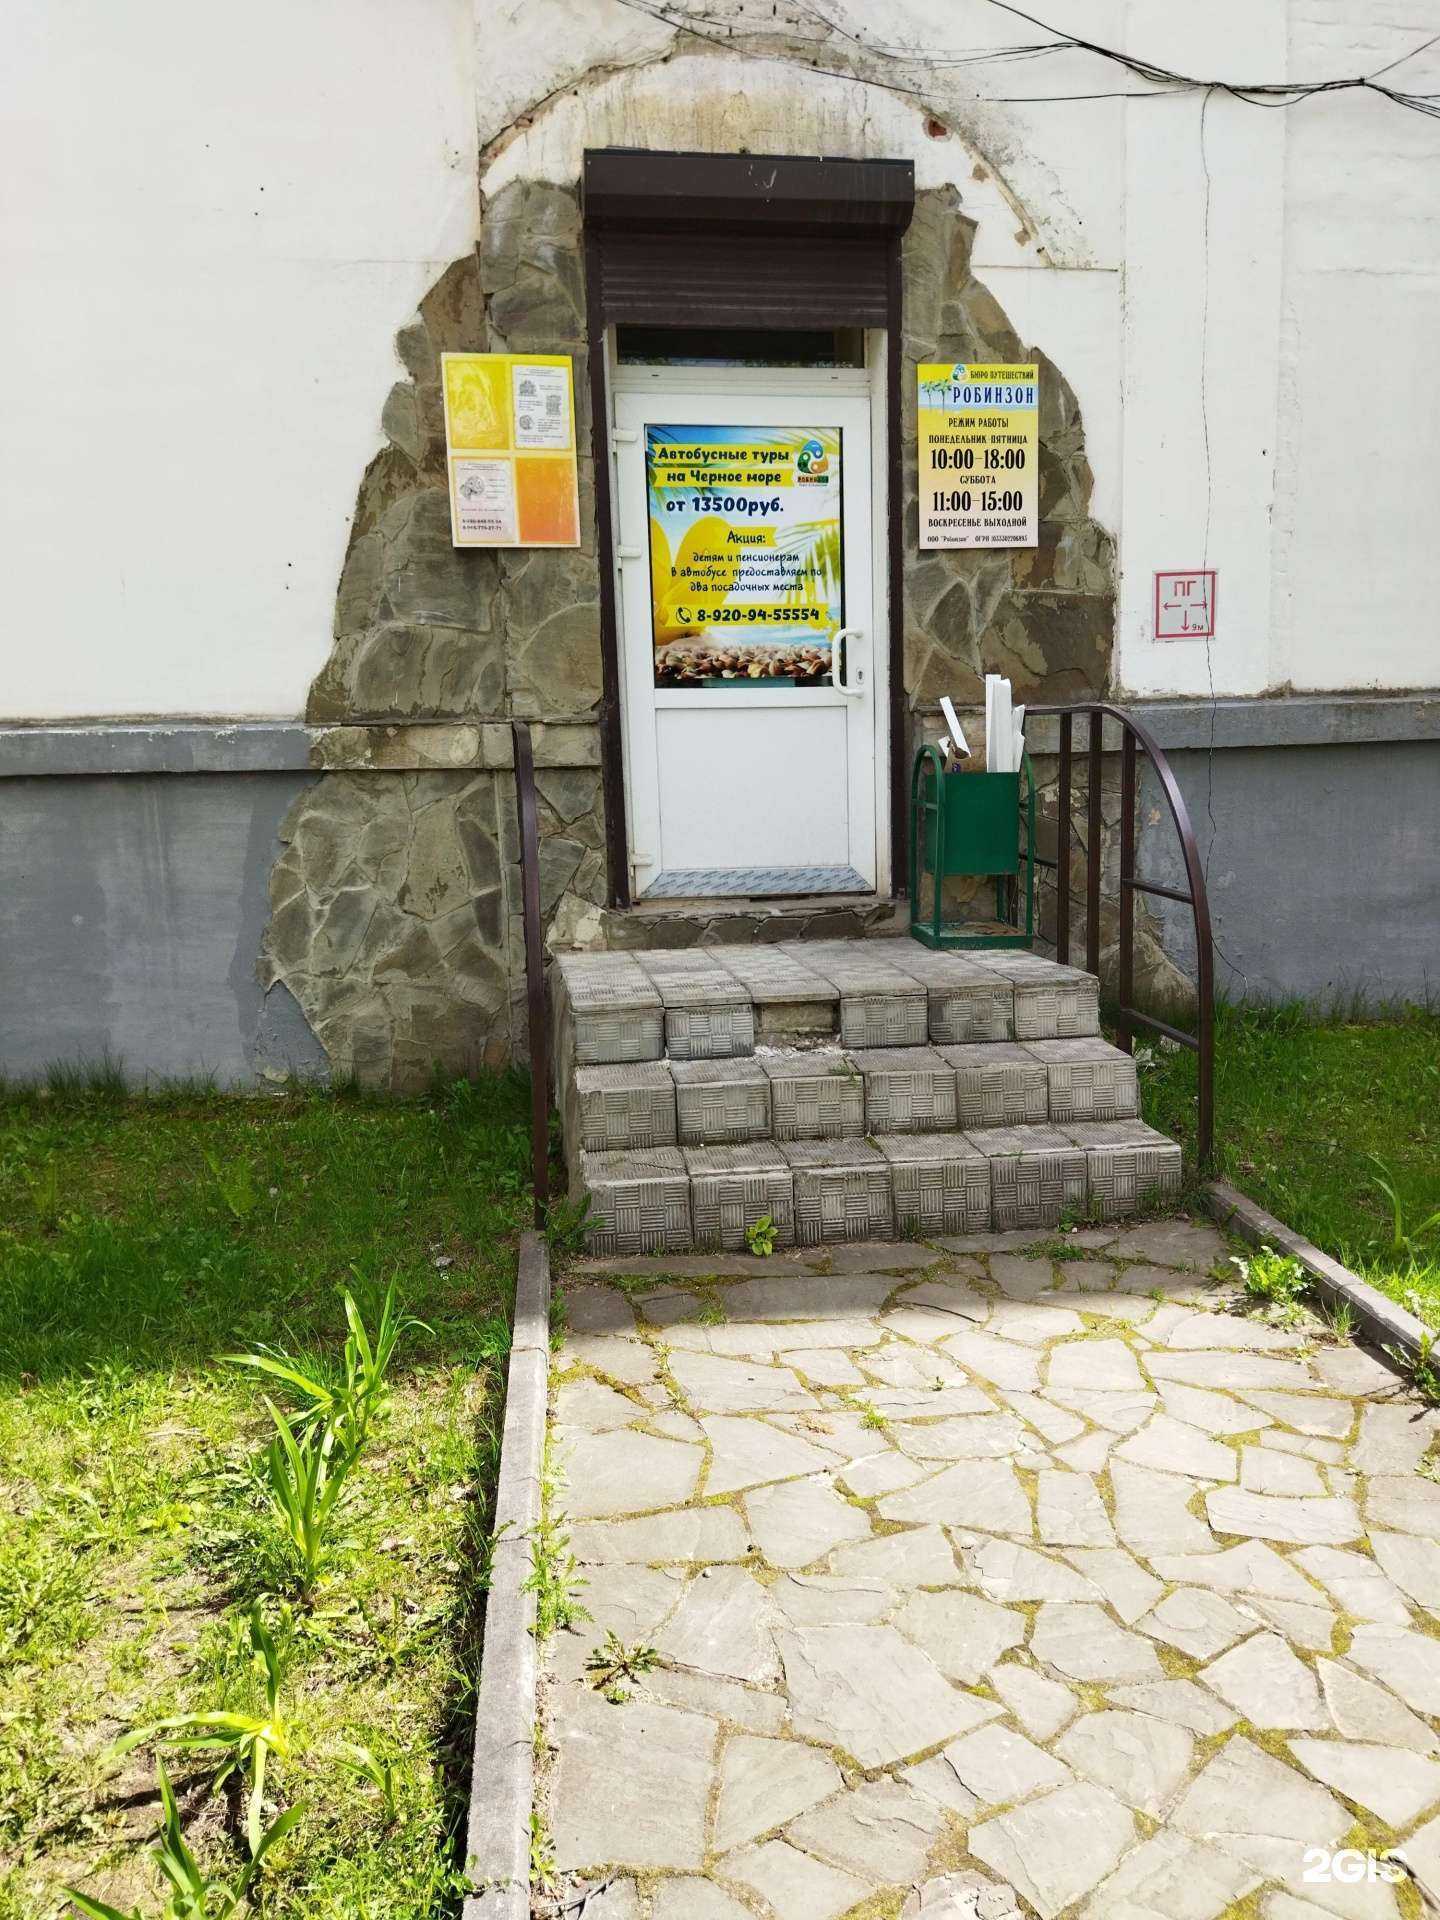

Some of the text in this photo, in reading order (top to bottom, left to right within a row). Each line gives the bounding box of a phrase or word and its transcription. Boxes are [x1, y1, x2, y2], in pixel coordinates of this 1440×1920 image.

[971, 370, 1034, 379] БЮРО ПУТЕШЕСТВИЙ
[953, 386, 1033, 404] РОБИНЗОН
[948, 418, 1009, 428] РЕЖИМ РАБОТЫ
[928, 435, 1028, 444] ПОНЕДЕЛЬНИК ПЯТНИЦА
[658, 447, 789, 465] Автобусные туры
[666, 470, 782, 487] на Черное море
[959, 475, 996, 484] СУББОТА
[666, 497, 784, 516] от 13500руб.
[928, 516, 1027, 528] ВОСКРЕСЕНЬЕ ВЫХОДНОЙ
[726, 530, 766, 545] Акция:
[693, 552, 725, 562] детям
[736, 552, 800, 567] пенсионерам
[671, 566, 823, 582] в автобусе предоставляем по
[690, 582, 804, 592] два посадочных места
[1174, 580, 1197, 597] ПГ
[697, 608, 820, 622] 8-920-94-55554
